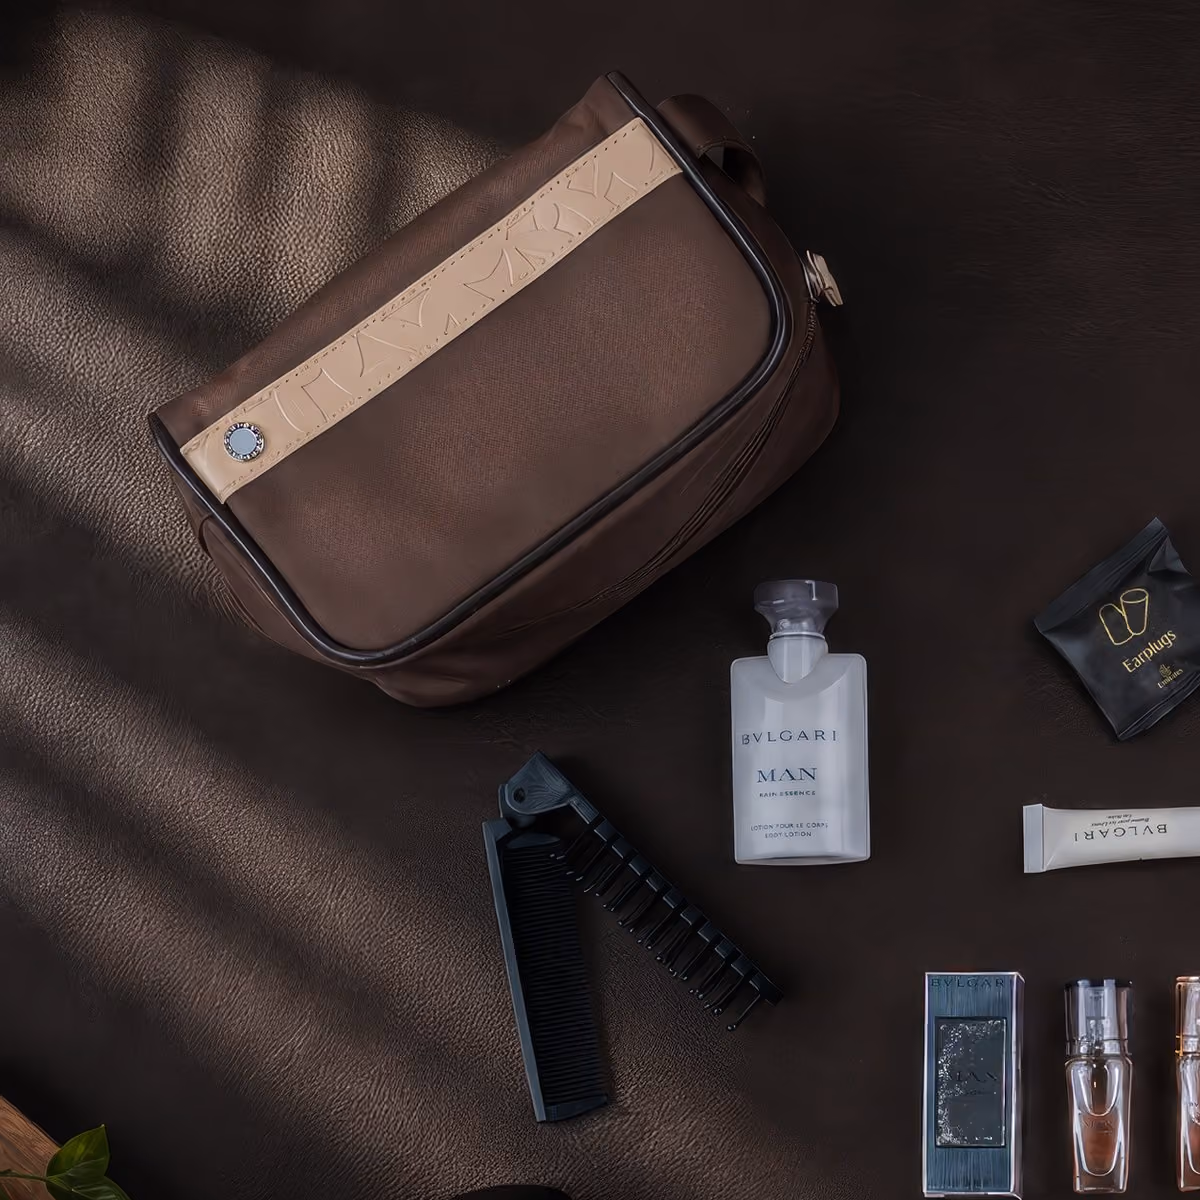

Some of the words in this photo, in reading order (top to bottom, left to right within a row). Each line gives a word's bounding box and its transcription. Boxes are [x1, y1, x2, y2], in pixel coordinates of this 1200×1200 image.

[1122, 629, 1177, 673] Earplugs
[741, 729, 837, 746] BVLGARI
[756, 767, 818, 784] MAN
[1074, 823, 1169, 842] BVLGARI
